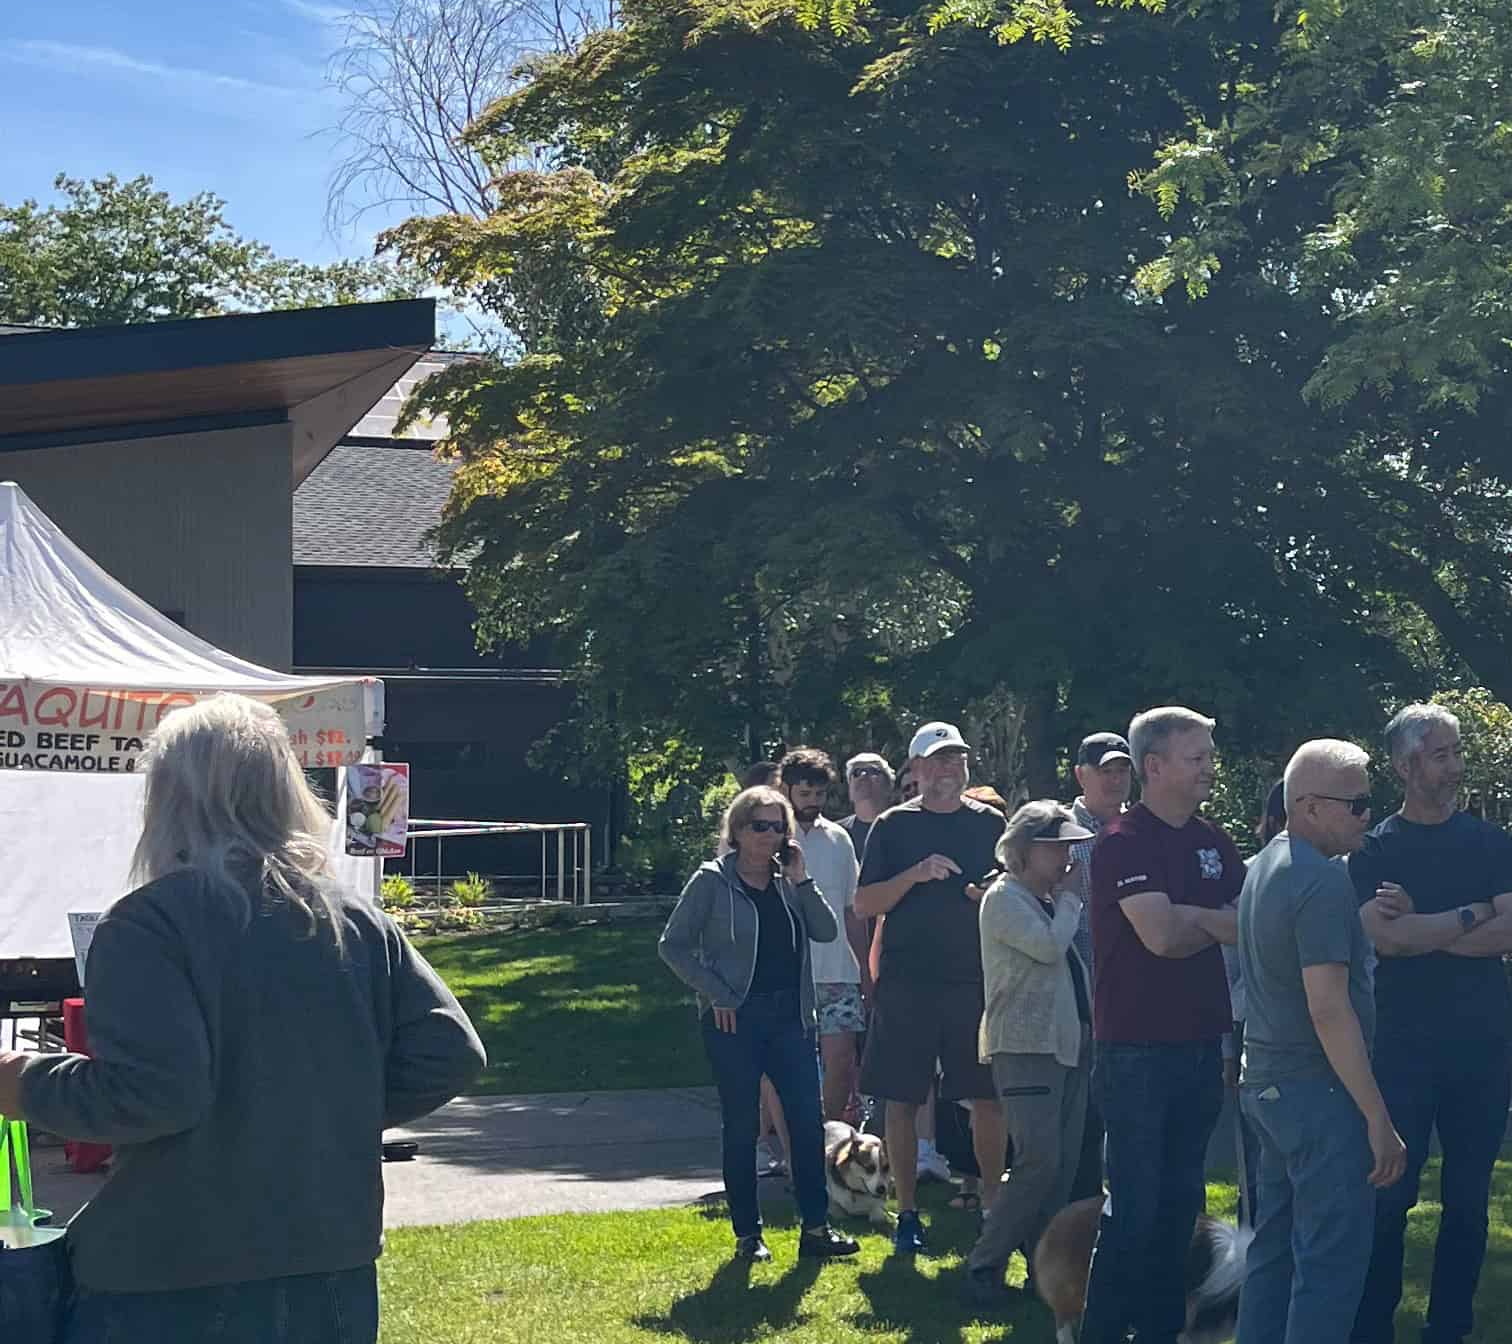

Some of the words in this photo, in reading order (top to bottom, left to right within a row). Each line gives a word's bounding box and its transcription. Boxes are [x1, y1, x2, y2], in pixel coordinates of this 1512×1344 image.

[0, 683, 197, 732] AQUITO
[37, 732, 101, 751] BEEF
[110, 736, 145, 752] TA
